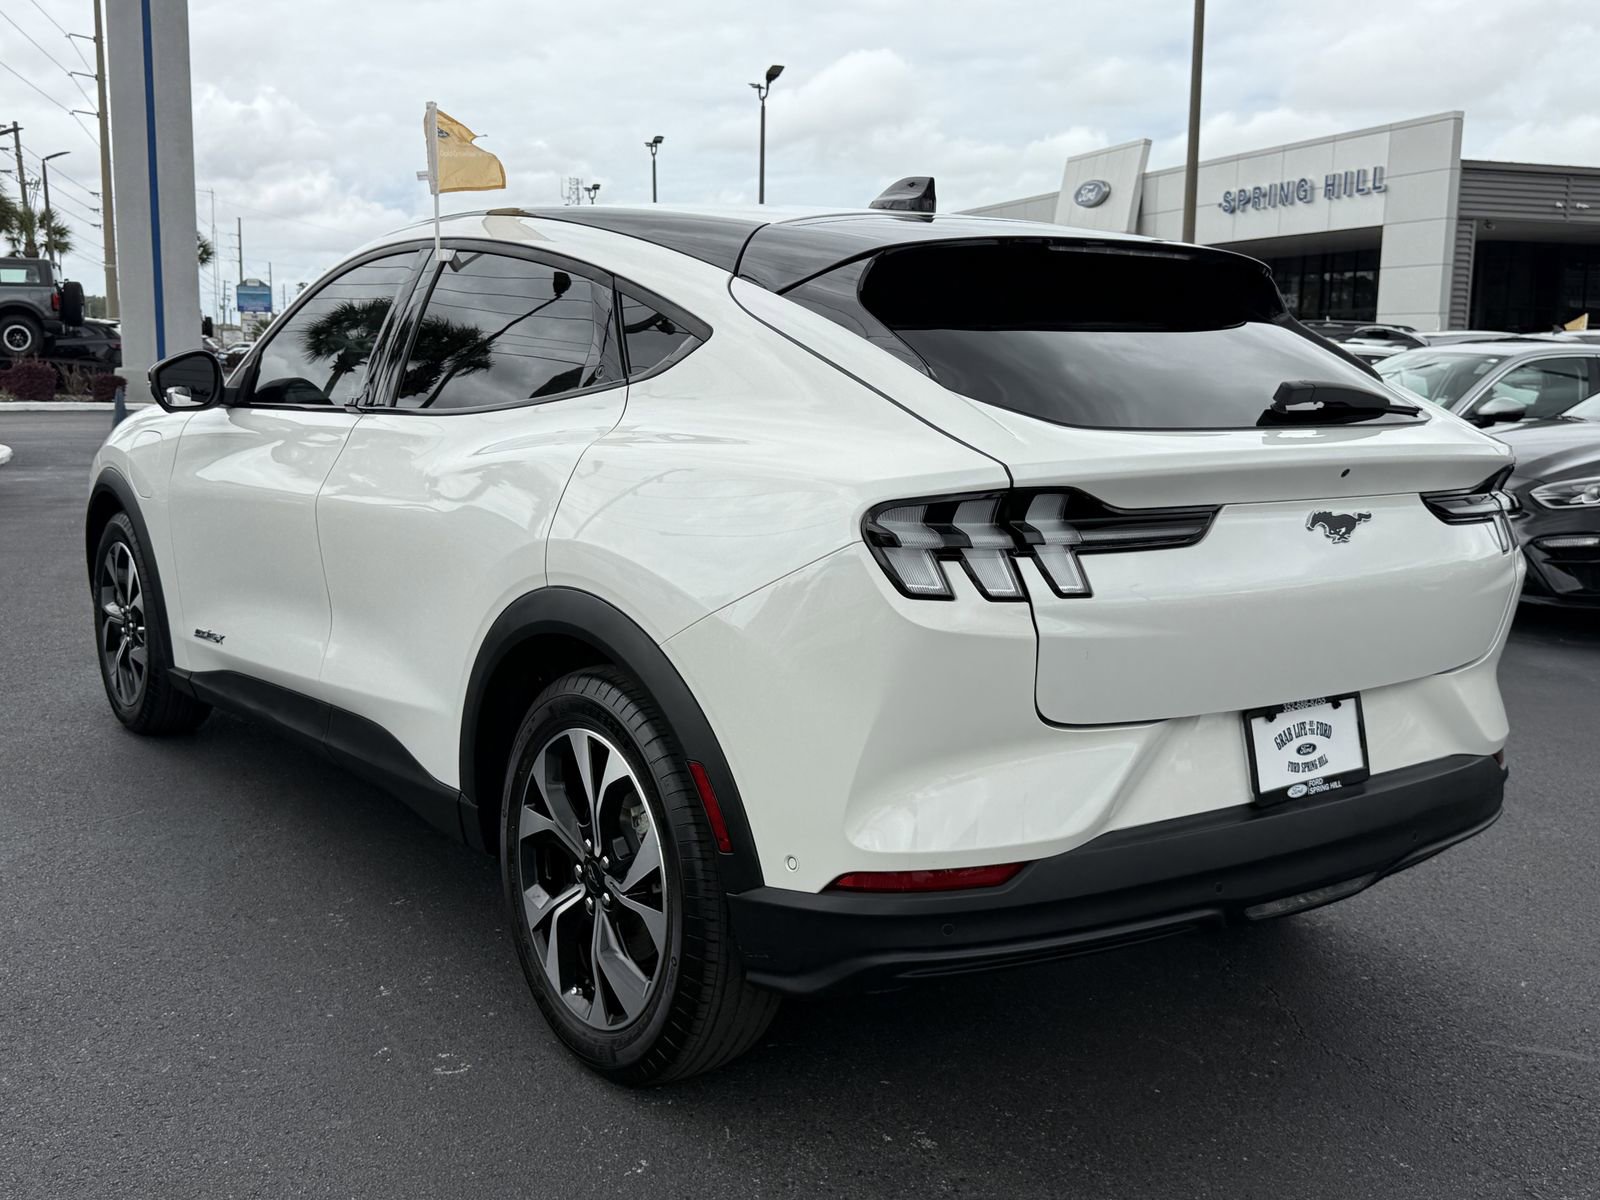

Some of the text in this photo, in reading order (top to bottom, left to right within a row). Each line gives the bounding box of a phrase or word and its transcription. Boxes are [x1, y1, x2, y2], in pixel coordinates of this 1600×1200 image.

[1076, 182, 1102, 204] Ford
[1221, 166, 1388, 214] SPRING HILL
[1274, 727, 1294, 750] GRAB
[1292, 721, 1307, 739] LIFE
[1316, 721, 1332, 739] FORD
[1299, 744, 1314, 755] Ford
[1288, 754, 1328, 773] FORD SPRING HILL
[1308, 778, 1323, 787] FORD
[1309, 780, 1342, 795] SPRING HILL
